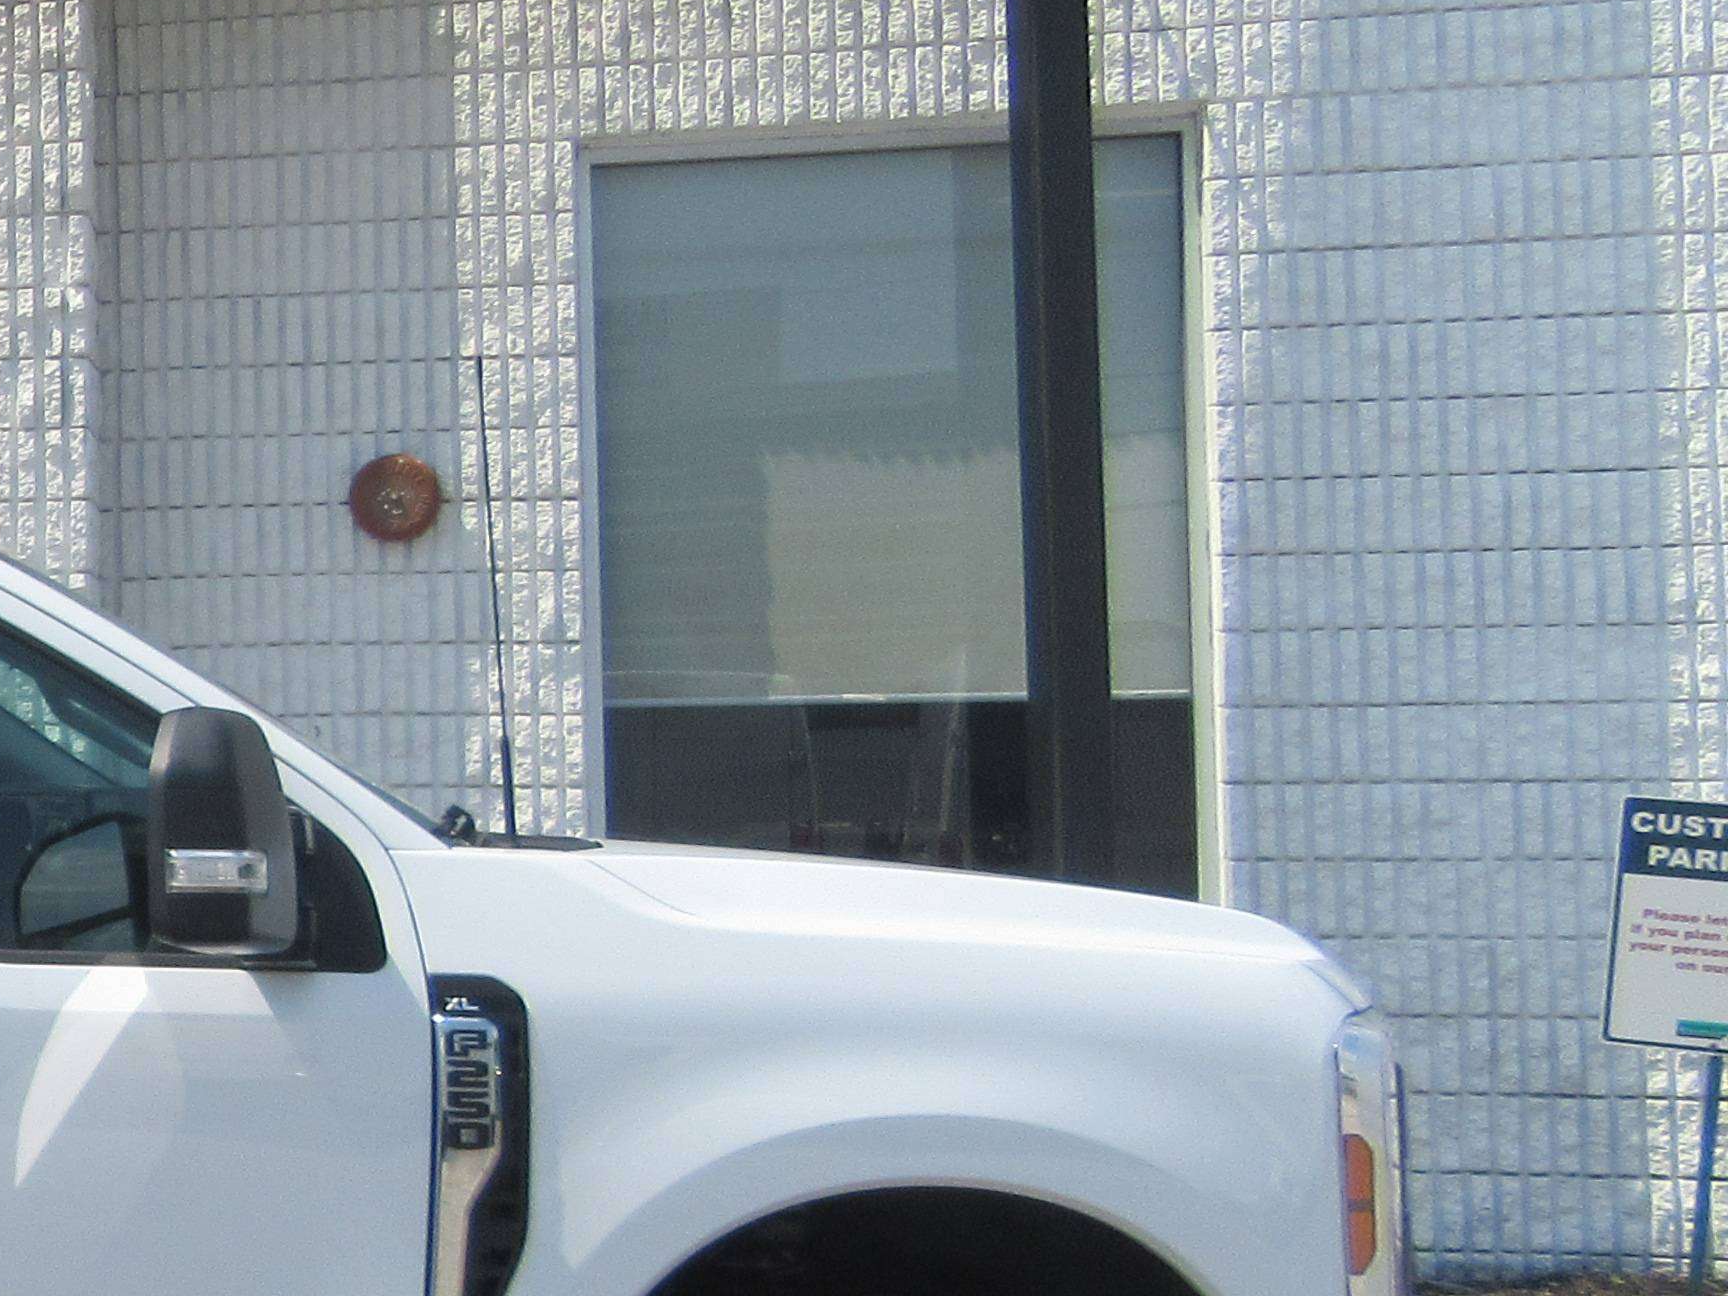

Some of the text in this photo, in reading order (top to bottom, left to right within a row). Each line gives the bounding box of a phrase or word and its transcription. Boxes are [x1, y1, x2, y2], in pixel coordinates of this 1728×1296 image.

[1643, 908, 1700, 924] Please
[1647, 926, 1679, 940] you
[443, 996, 480, 1012] XL
[444, 1029, 491, 1148] F250
